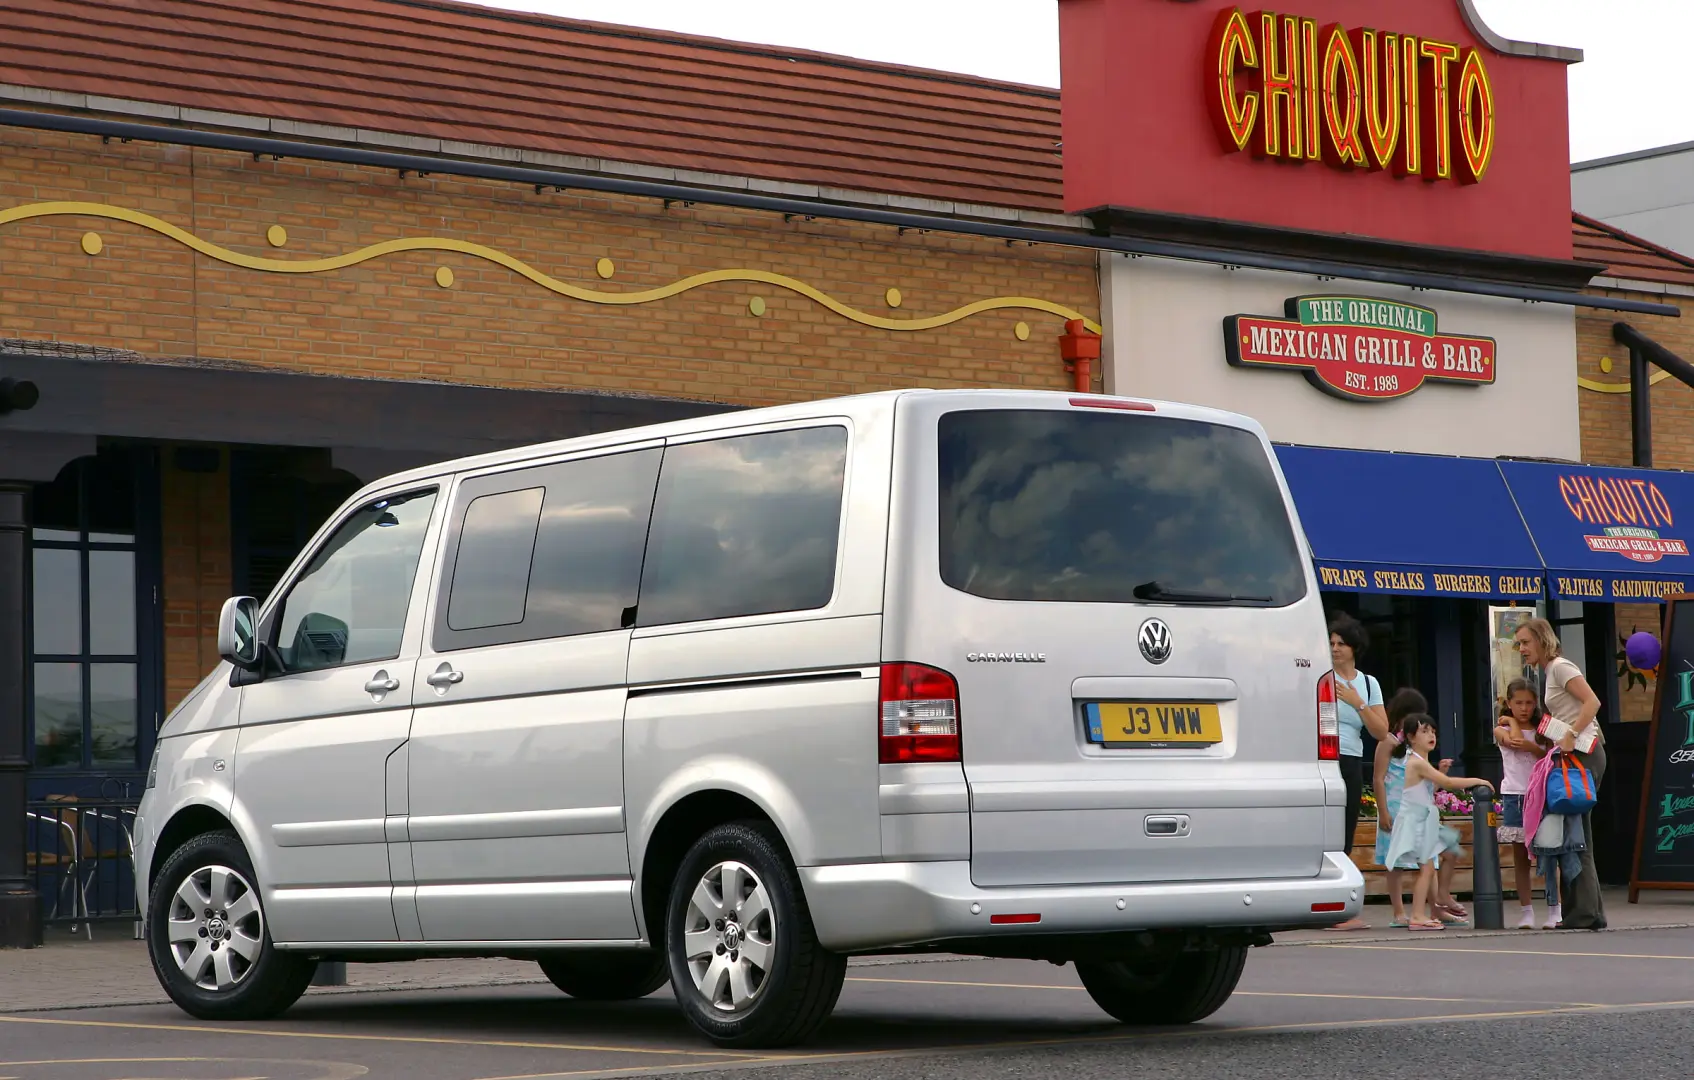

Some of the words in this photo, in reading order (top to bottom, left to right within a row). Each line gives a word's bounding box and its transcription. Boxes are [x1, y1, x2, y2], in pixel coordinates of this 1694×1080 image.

[1214, 5, 1496, 185] CHIQUITO
[1309, 300, 1345, 322] THE
[1349, 301, 1426, 333] ORIGINAL
[1250, 325, 1348, 362] MEXICAN
[1354, 334, 1416, 368] GRILL
[1421, 341, 1438, 370] &
[1442, 343, 1484, 374] BAR
[1344, 370, 1370, 390] EST.
[1373, 374, 1399, 392] 1989
[1558, 474, 1674, 528] CHIQUITO
[1589, 538, 1631, 550] MEXICAN
[1630, 540, 1657, 552] GRILL
[1665, 541, 1685, 553] BAR
[1608, 528, 1623, 537] THE
[1623, 528, 1656, 539] ORIGINAL
[1319, 566, 1368, 588] WRAPS
[1373, 570, 1425, 591] STEAKS
[1433, 573, 1491, 594] BURGERS
[1498, 575, 1541, 594] GRILLS
[1557, 577, 1604, 597] FAJITAS
[1611, 579, 1685, 598] SANDWICHES
[966, 652, 1046, 663] CARAVELLE
[1122, 707, 1152, 735] J3
[1155, 707, 1202, 735] VWW
